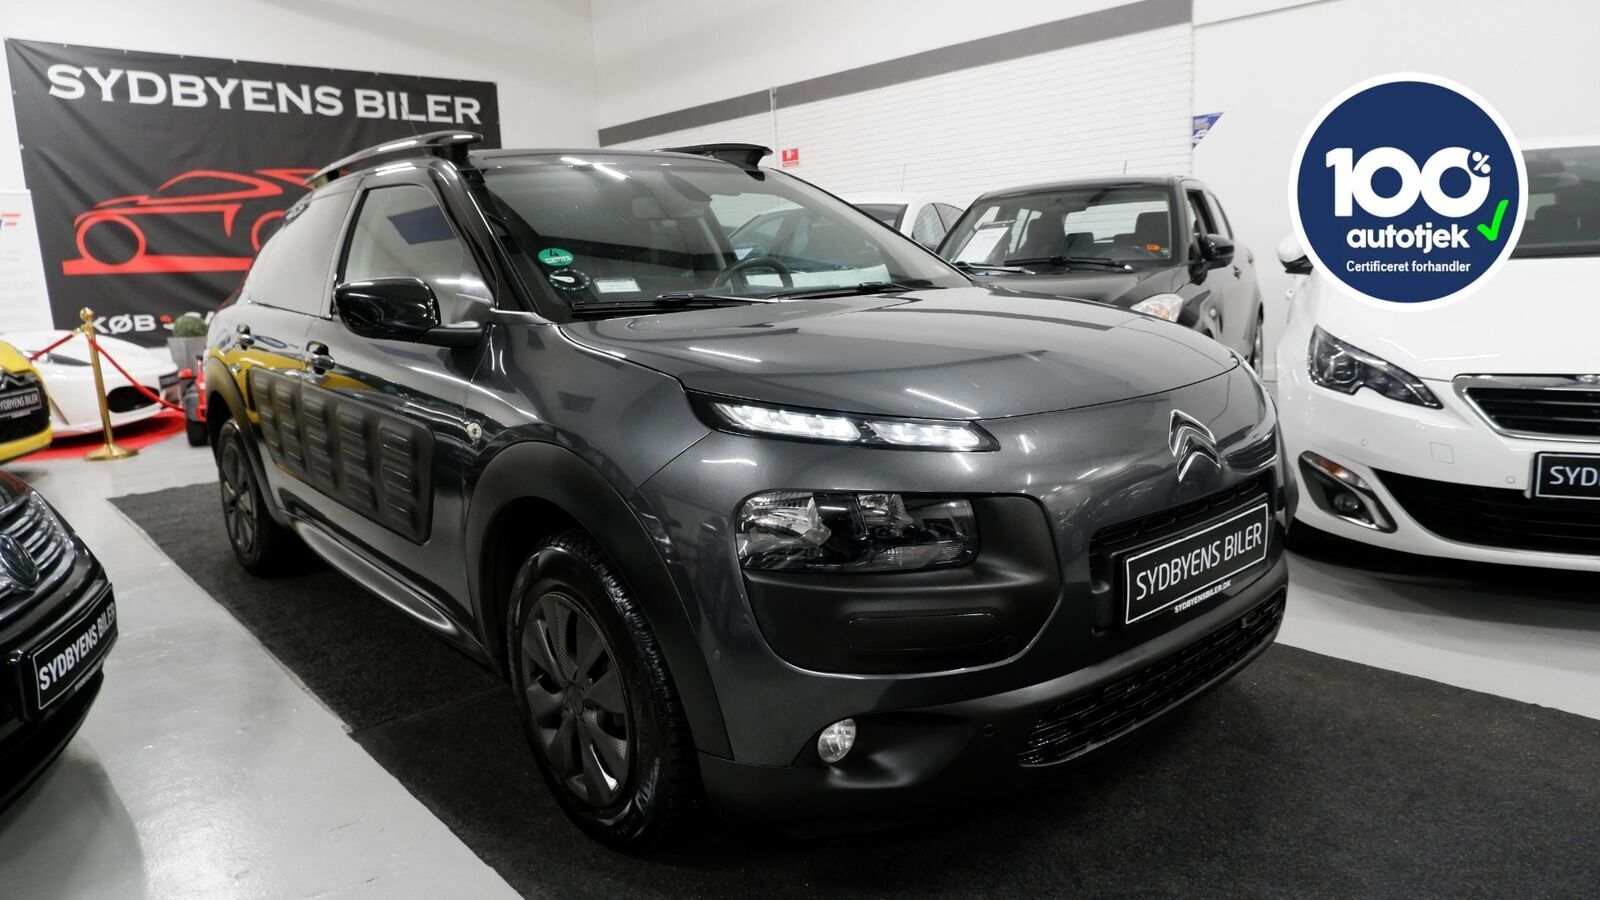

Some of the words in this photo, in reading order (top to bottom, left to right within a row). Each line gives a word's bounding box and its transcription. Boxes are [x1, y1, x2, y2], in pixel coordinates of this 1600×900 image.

[48, 64, 343, 117] SYDBYENS
[355, 91, 482, 124] BILER
[92, 312, 156, 334] KØB
[1549, 465, 1600, 487] SYD
[1136, 540, 1221, 601] SYDBYENS
[1224, 522, 1262, 561] BILER
[1174, 580, 1232, 614] SYDBYENSBILER.DK
[39, 624, 97, 690] SYDBYENS
[97, 602, 116, 638] BILER
